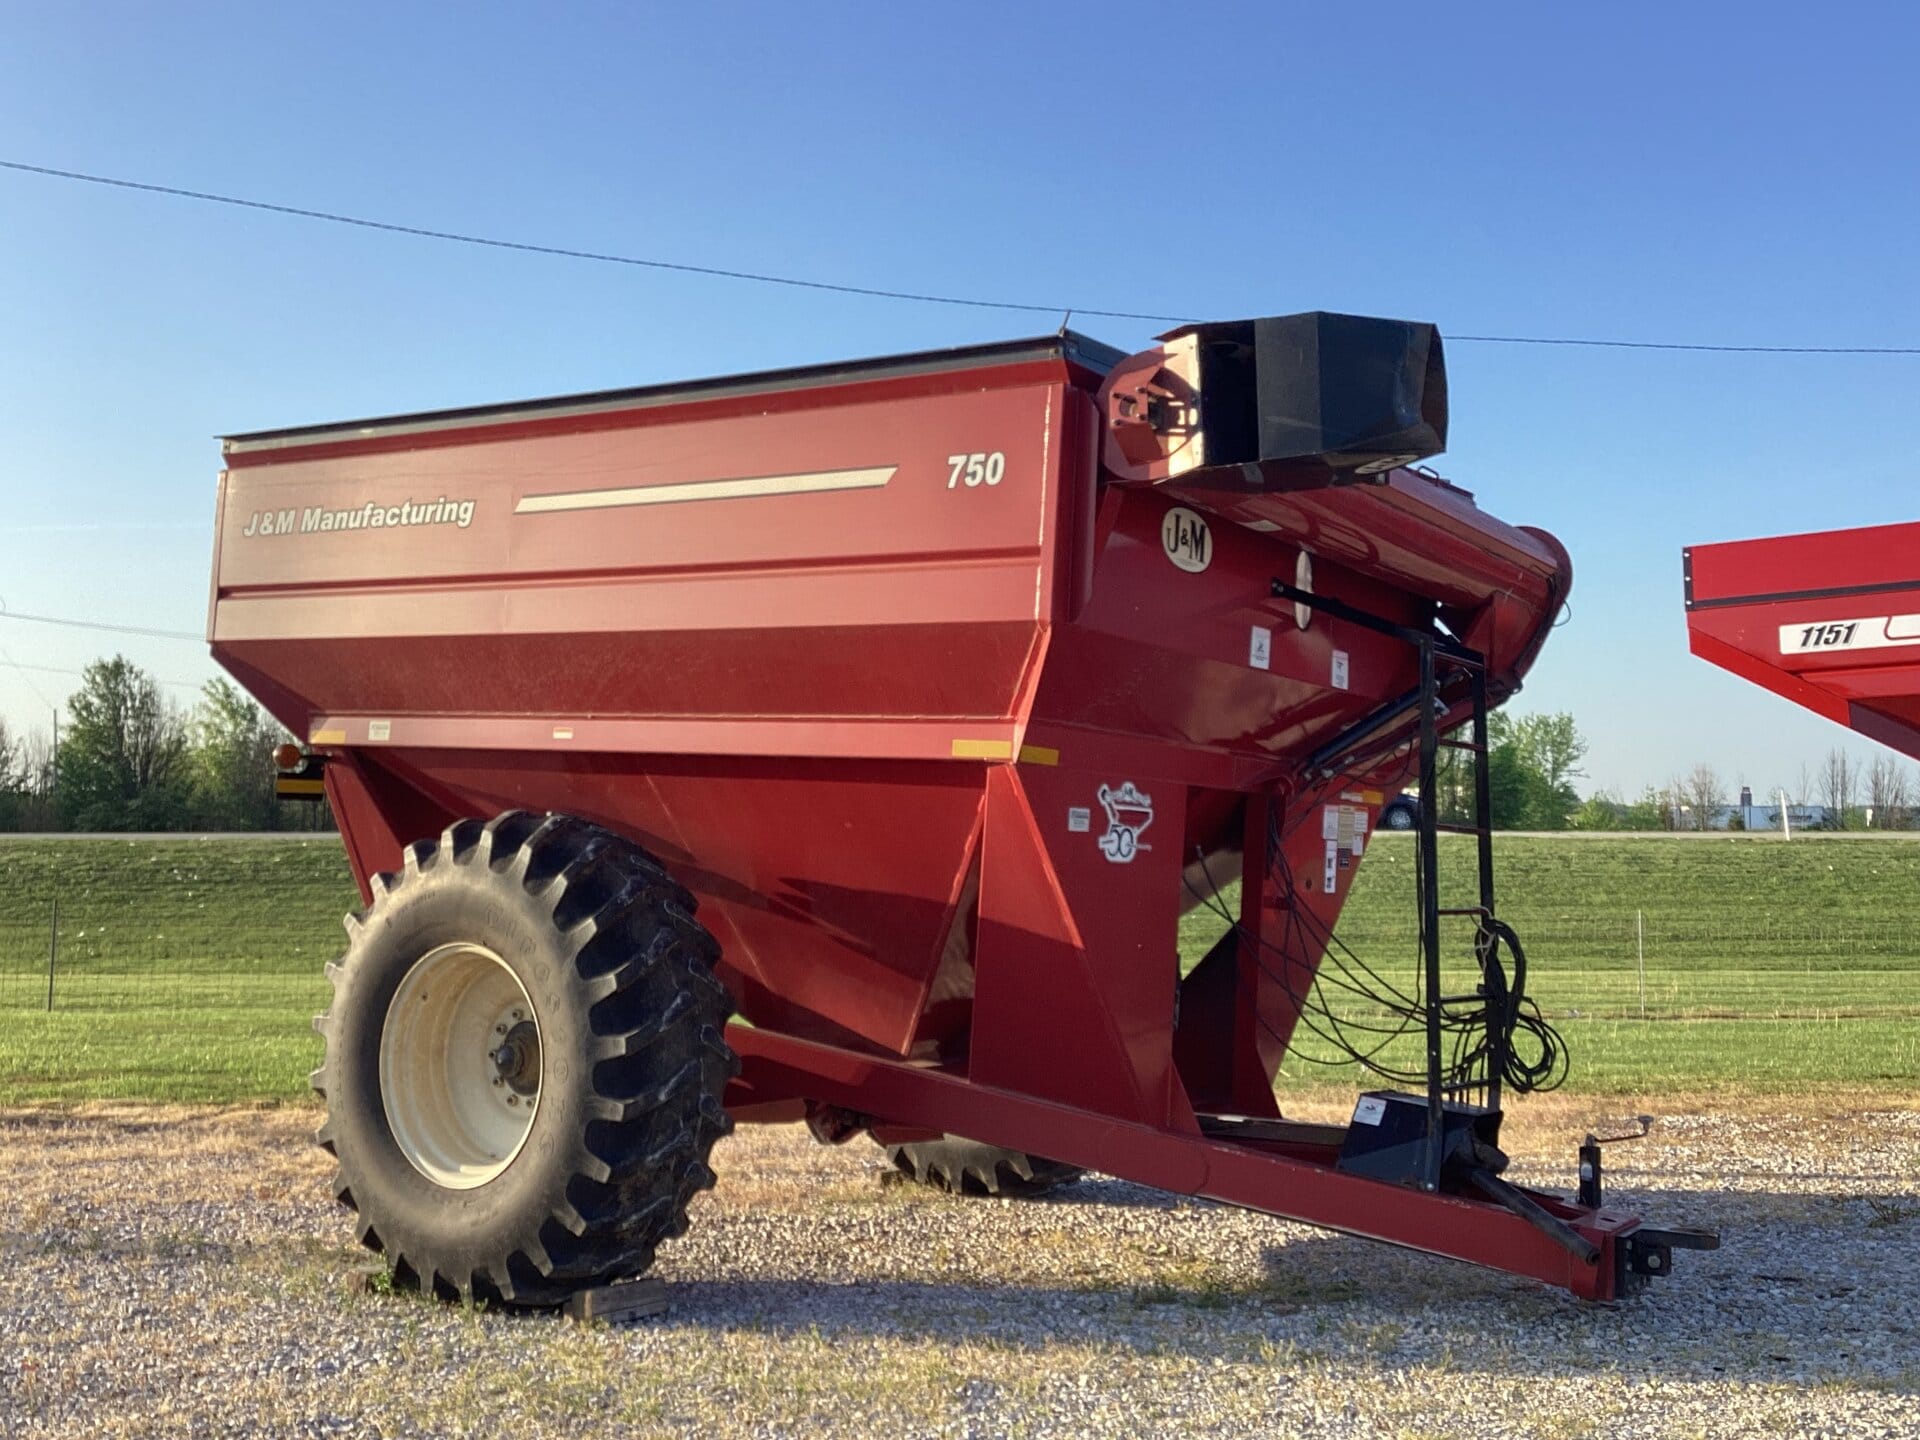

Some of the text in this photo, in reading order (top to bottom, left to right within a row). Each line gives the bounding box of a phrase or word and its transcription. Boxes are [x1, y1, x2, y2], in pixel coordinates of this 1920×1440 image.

[946, 451, 1006, 490] 750
[242, 497, 476, 537] J&M Manufacturing
[1166, 513, 1207, 564] J&M
[1800, 622, 1859, 648] 1151
